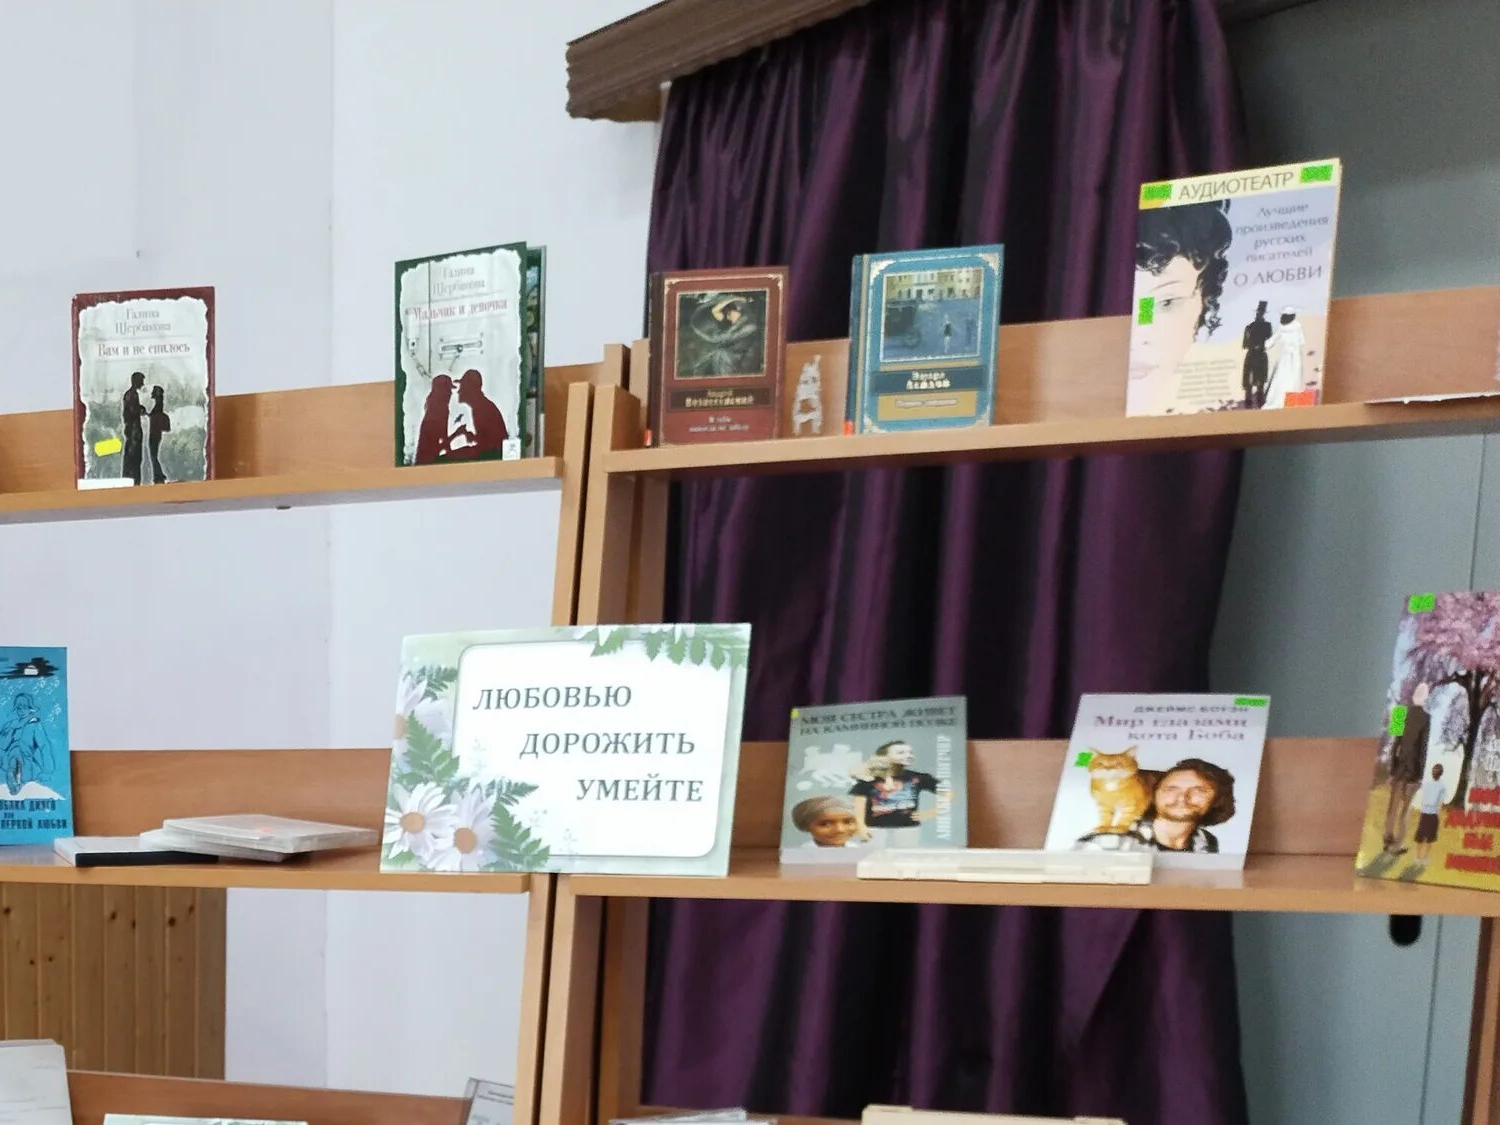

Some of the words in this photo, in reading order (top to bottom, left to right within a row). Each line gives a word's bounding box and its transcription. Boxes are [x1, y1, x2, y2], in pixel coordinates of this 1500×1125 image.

[1178, 171, 1294, 201] АУДИОТЕАТР
[1257, 203, 1308, 217] Лучшие
[1235, 216, 1329, 235] произведения
[1254, 234, 1306, 250] русских
[1246, 248, 1313, 263] писателей
[1233, 273, 1248, 287] О
[1252, 265, 1322, 284] ЛЮБВИ
[126, 308, 160, 320] Галина
[412, 304, 455, 321] Мальчик
[458, 304, 465, 315] и
[115, 321, 171, 336] Щербакова
[98, 343, 119, 357] Вам
[122, 345, 129, 355] и
[133, 345, 144, 355] не
[148, 342, 190, 354] снилось
[472, 685, 632, 710] ЛЮБОВЬЮ
[1093, 715, 1144, 728] Мир
[1152, 717, 1247, 728] глазами
[1127, 732, 1178, 741] кота
[1188, 729, 1245, 741] Боба
[519, 732, 695, 760] ДОРОЖИТЬ
[576, 773, 703, 802] УМЕЙТЕ
[1, 818, 33, 830] ПЕРВОЙ
